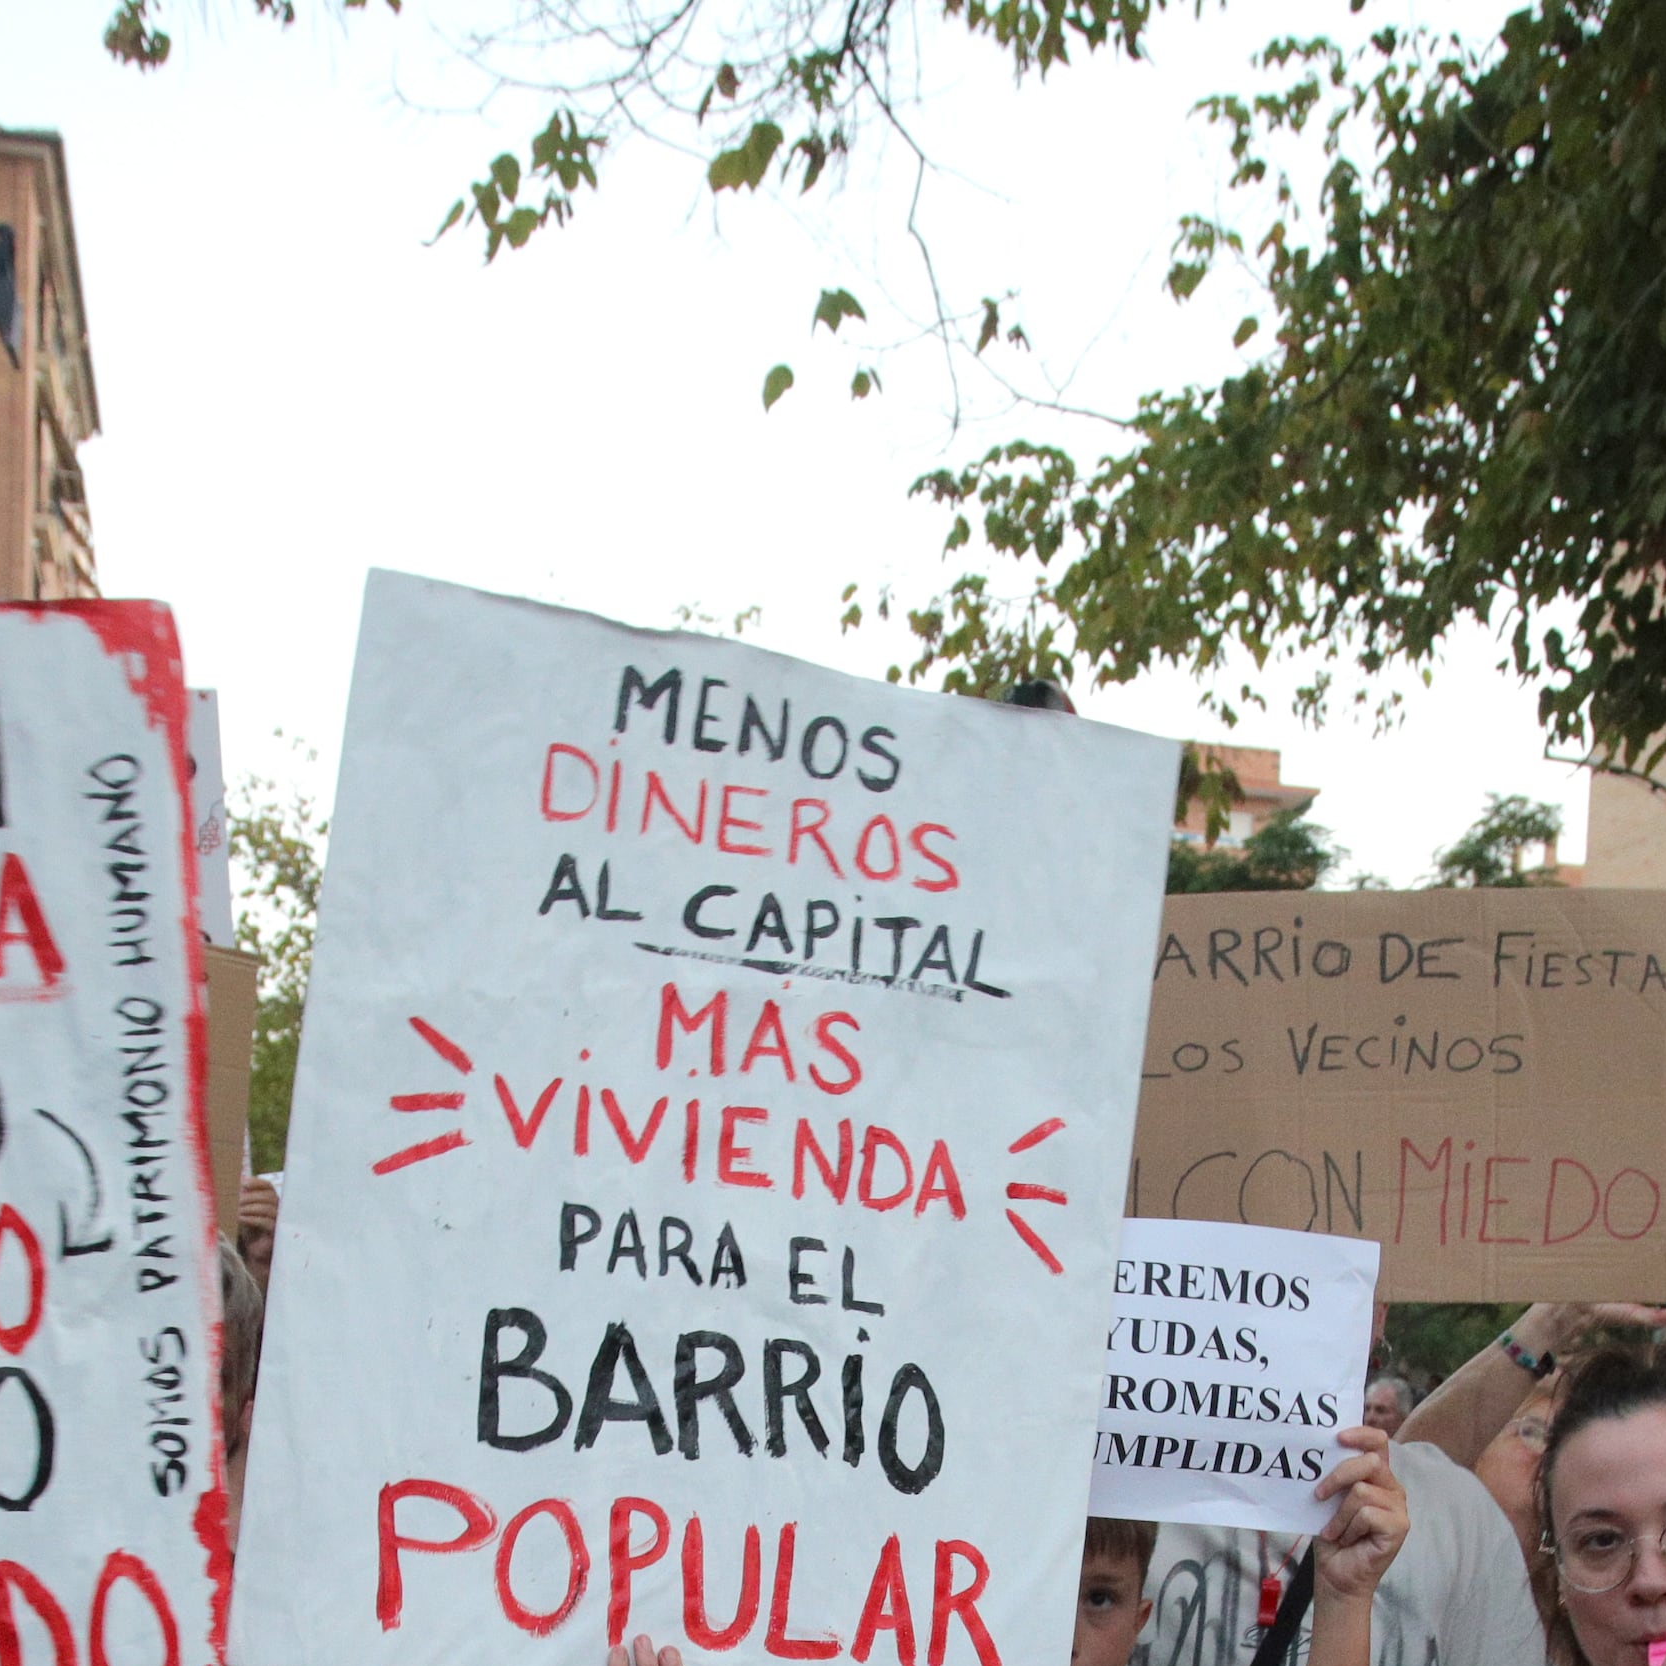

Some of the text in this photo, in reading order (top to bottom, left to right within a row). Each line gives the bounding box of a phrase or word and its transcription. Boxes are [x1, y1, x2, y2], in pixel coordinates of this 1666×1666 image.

[614, 664, 901, 792] MENOS
[538, 853, 643, 921] AL
[1379, 932, 1465, 985] DE
[83, 752, 187, 1497] SOMOS PATRIMONIO HUMANO
[558, 1202, 885, 1316] PARA EL
